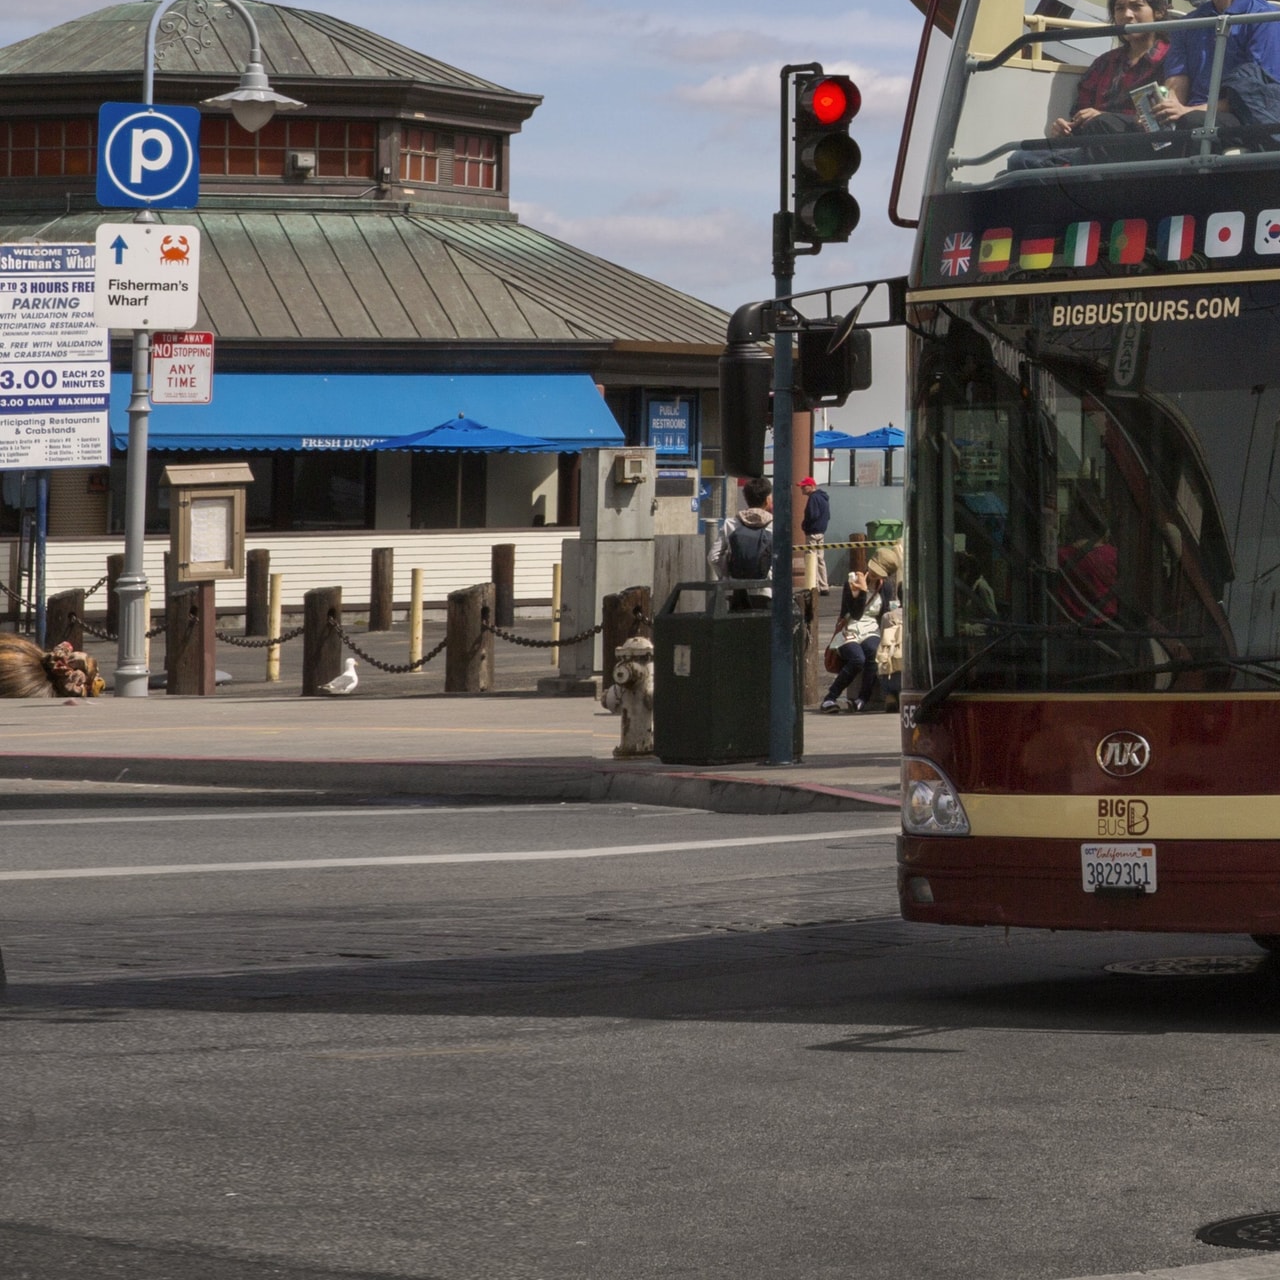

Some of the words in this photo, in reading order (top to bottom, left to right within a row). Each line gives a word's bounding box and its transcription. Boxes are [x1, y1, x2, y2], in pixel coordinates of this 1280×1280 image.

[13, 248, 63, 256] WELCOME
[67, 248, 80, 256] TO
[8, 282, 18, 291] TO
[20, 282, 27, 294] 3
[30, 282, 69, 294] HOURS
[72, 281, 95, 293] FREE
[108, 279, 189, 292] Fisherman's
[12, 297, 80, 310] PARKING
[108, 294, 149, 306] Wharf
[21, 312, 68, 320] VALIDATION
[72, 311, 95, 319] FROM
[1052, 296, 1241, 327] BIGBUSTOURS.COM
[50, 321, 99, 329] RESTAURAN
[56, 340, 104, 348] VALIDATION
[162, 334, 205, 343] TOW-AWAY
[14, 350, 68, 358] CRABSTANDS
[154, 344, 172, 357] NO
[173, 347, 211, 358] STOPPING
[62, 370, 88, 379] EACH
[90, 369, 105, 378] 20
[169, 364, 195, 375] ANY
[62, 379, 106, 389] MINUTES
[167, 377, 197, 388] TIME
[27, 398, 55, 407] DAILY
[58, 396, 105, 406] MAXIMUM
[659, 405, 680, 416] PUBLIC
[49, 416, 100, 425] Restaurants
[652, 418, 687, 430] RESTROOMS
[25, 426, 76, 435] Crabstands
[301, 438, 340, 448] FRESH
[1098, 799, 1126, 818] BIG
[1098, 818, 1126, 836] BUS
[1096, 846, 1141, 862] California
[1087, 862, 1152, 886] 38293C1
